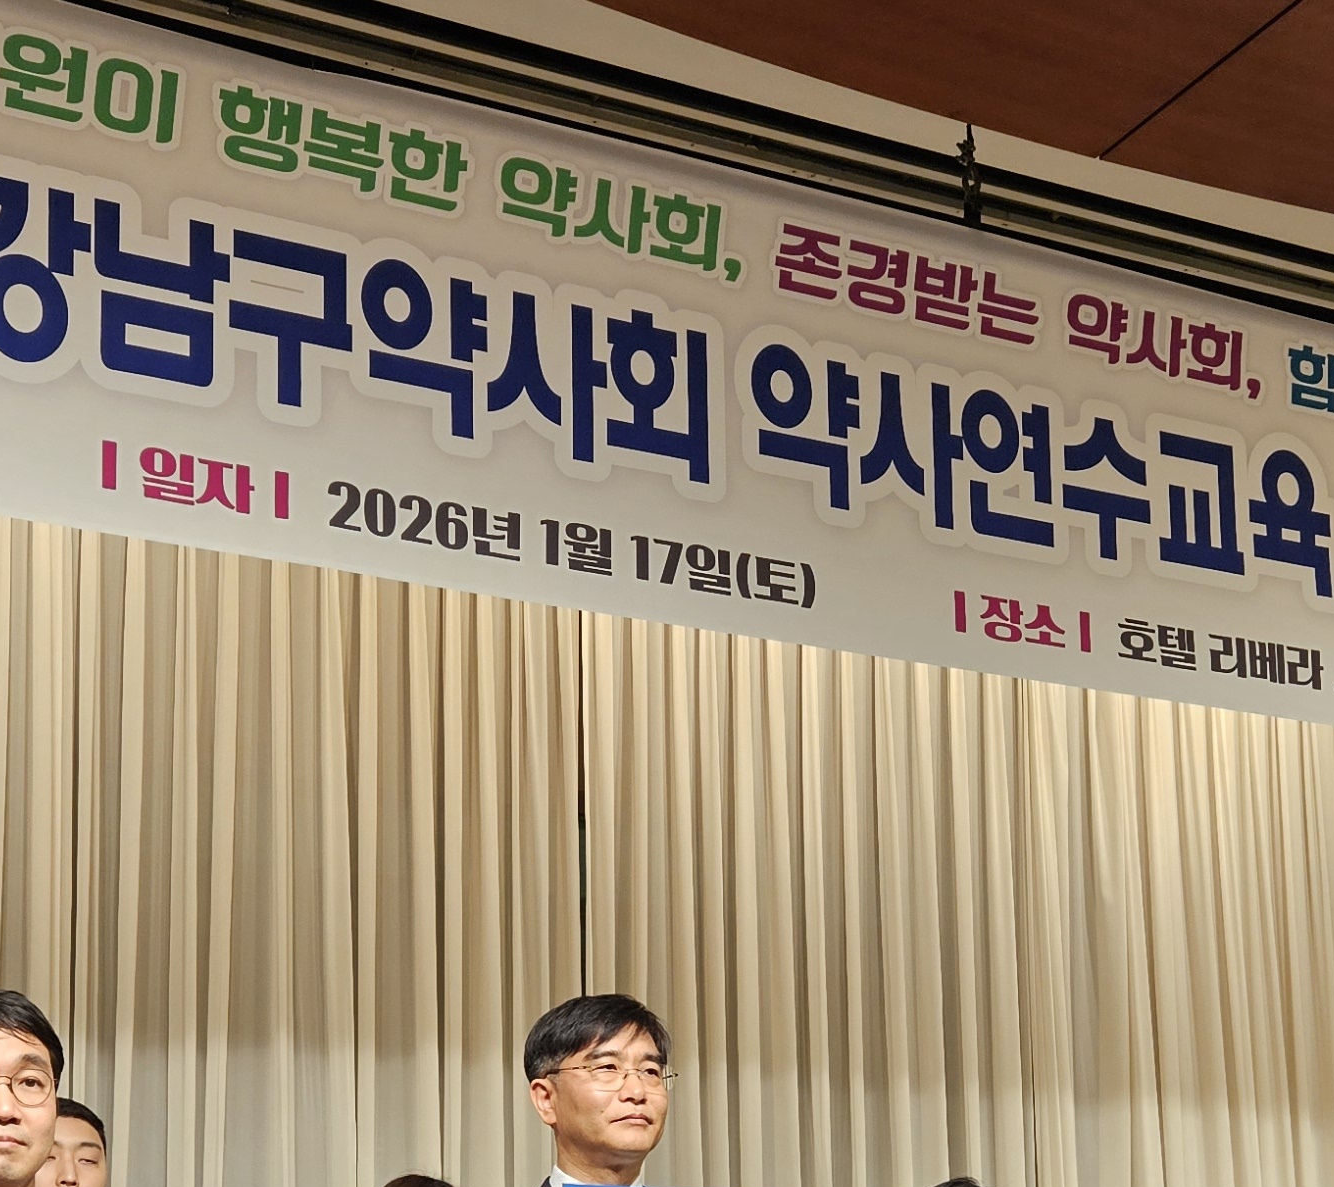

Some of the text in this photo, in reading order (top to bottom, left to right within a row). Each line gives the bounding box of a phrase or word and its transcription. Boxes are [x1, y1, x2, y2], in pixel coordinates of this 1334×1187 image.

[219, 85, 468, 211] 행복한
[501, 157, 741, 282] 약사회,
[775, 223, 1039, 345] 존경받는
[1067, 294, 1260, 400] 약사회,
[328, 482, 520, 561] 2026년
[541, 519, 612, 576] 1월
[631, 536, 815, 608] 17일(토)
[751, 343, 1333, 599] 약사연수교육
[1118, 618, 1197, 671] 호텔
[1208, 634, 1324, 690] 리베라
